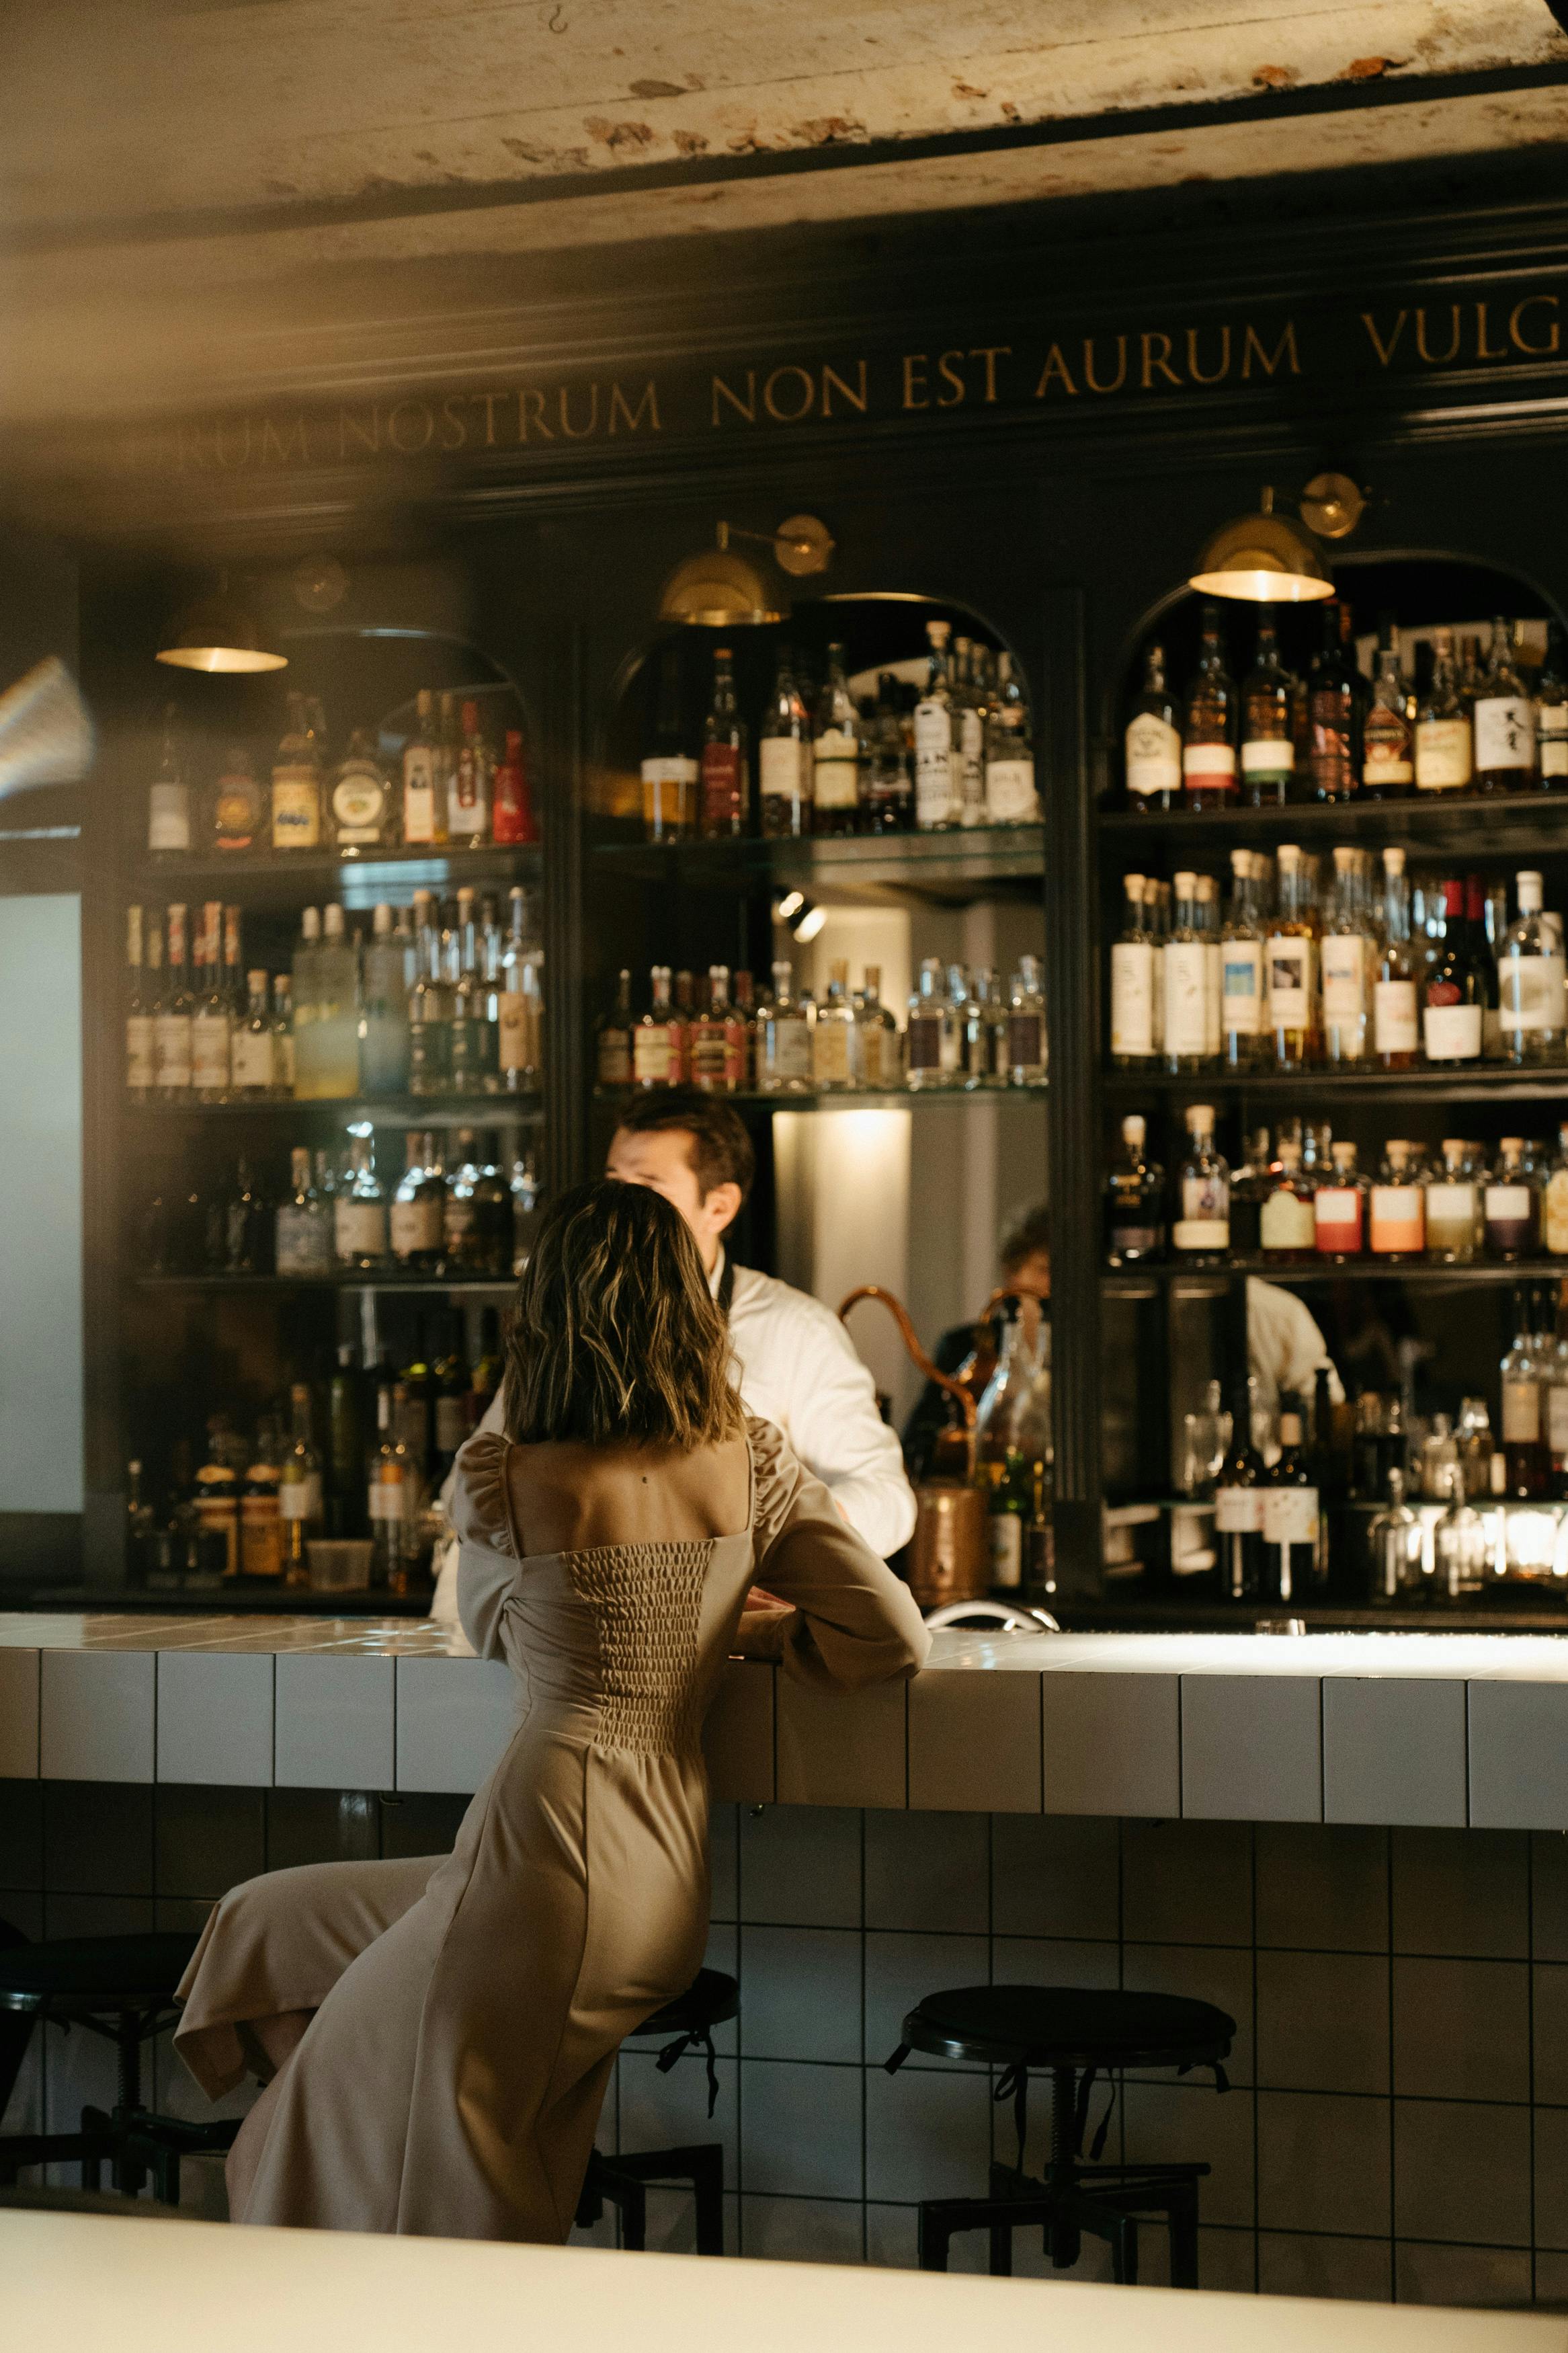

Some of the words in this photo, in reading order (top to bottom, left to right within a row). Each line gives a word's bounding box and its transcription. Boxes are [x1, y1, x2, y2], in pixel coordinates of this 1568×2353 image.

[339, 379, 662, 458] NOSTRUM
[711, 358, 868, 426] NON
[901, 345, 1012, 410] EST
[1034, 321, 1302, 398] AURUM
[1360, 294, 1561, 366] VULG
